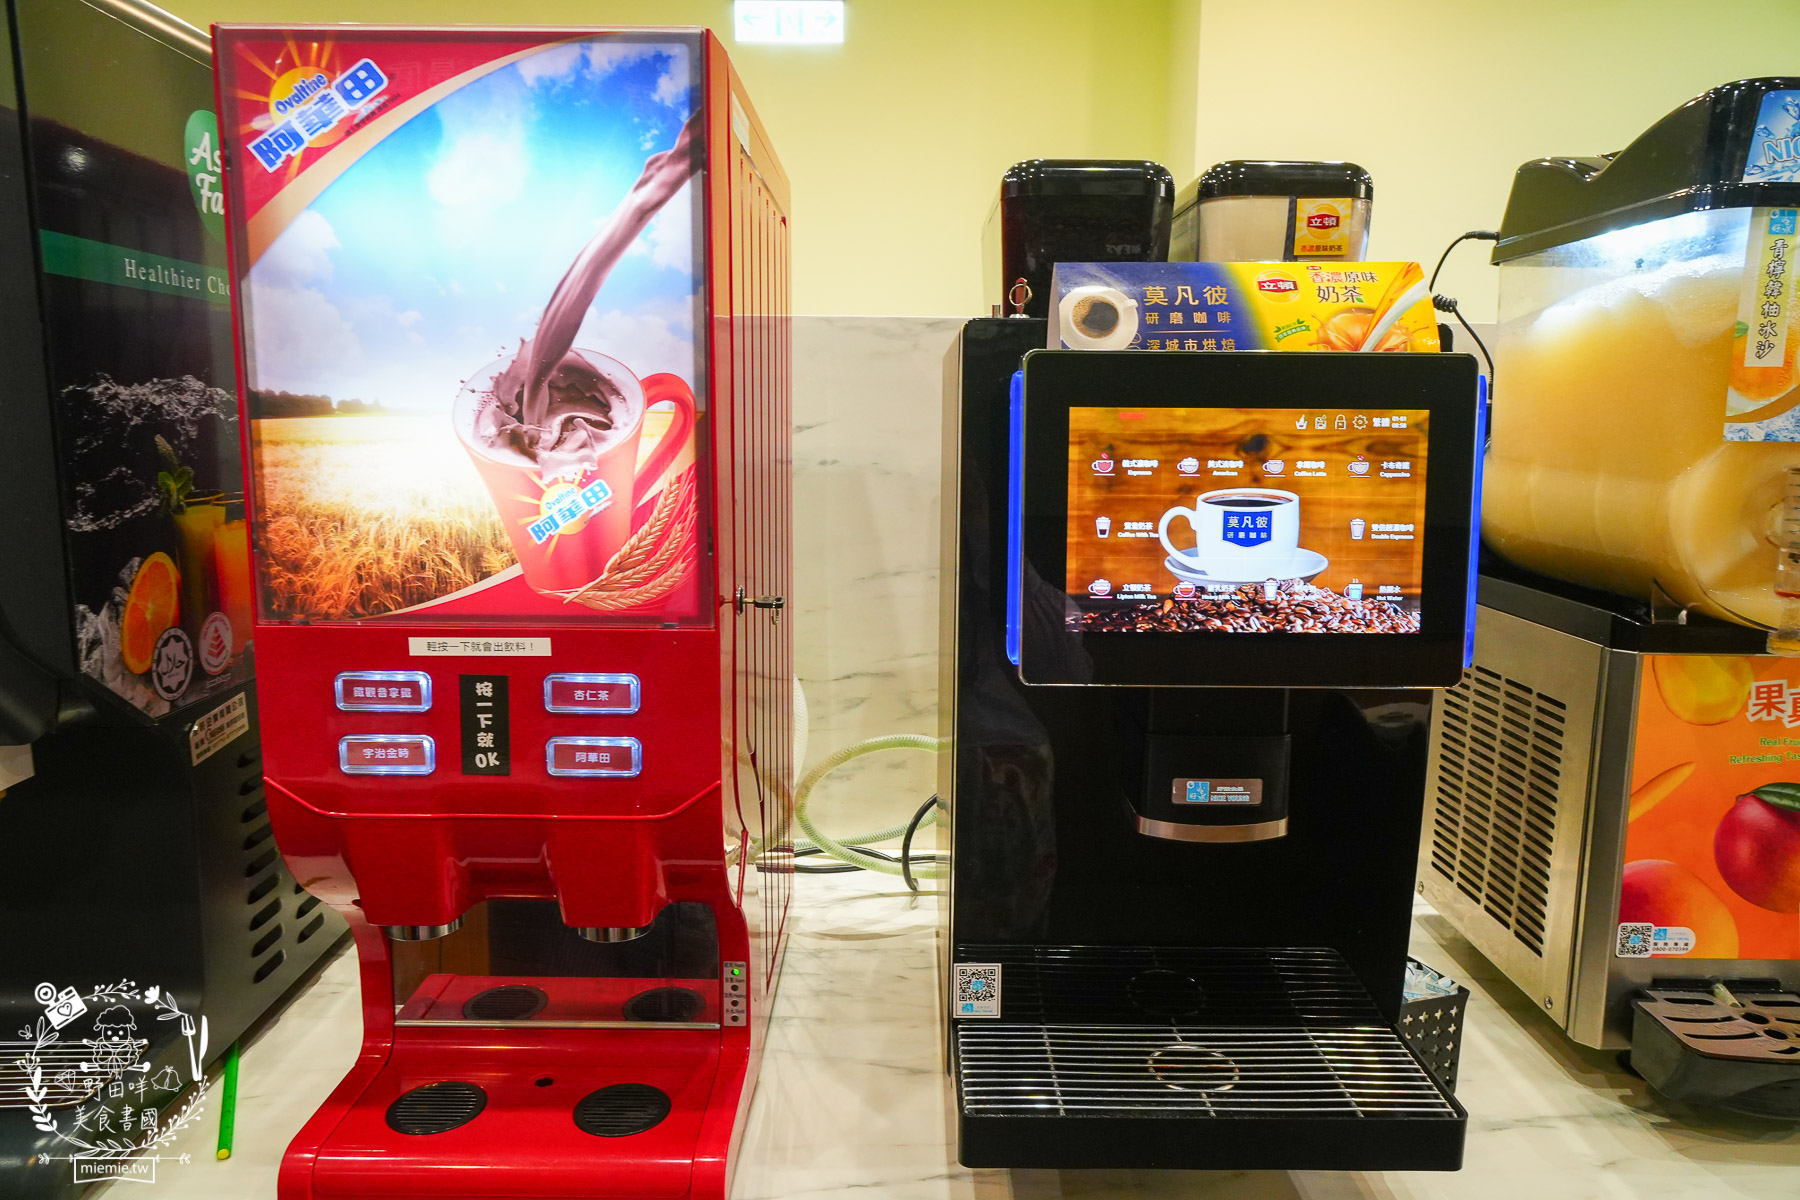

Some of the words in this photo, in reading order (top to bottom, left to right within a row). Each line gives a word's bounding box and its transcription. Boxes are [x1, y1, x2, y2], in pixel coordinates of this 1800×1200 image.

[274, 74, 328, 114] Ovaltine
[248, 59, 388, 172] 阿華田
[195, 173, 225, 215] Fa
[1309, 216, 1337, 226] 立頓
[124, 258, 201, 290] Healthier
[1309, 271, 1379, 283] 香濃原味
[1261, 281, 1296, 290] 立頓
[1142, 285, 1229, 306] 莫凡彼
[1316, 286, 1365, 303] 奶茶
[1145, 311, 1232, 325] 研磨咖啡
[545, 487, 577, 511] Ovaltine
[528, 480, 611, 543] 阿華田
[1227, 515, 1269, 528] 莫凡彼
[353, 686, 412, 698] 鐵觀音拿鐵
[574, 690, 609, 701] 杏仁茶
[1760, 737, 1781, 746] Real
[363, 748, 409, 759] 宇治金時
[576, 752, 610, 763] 阿華田
[1729, 754, 1782, 764] Refreshing
